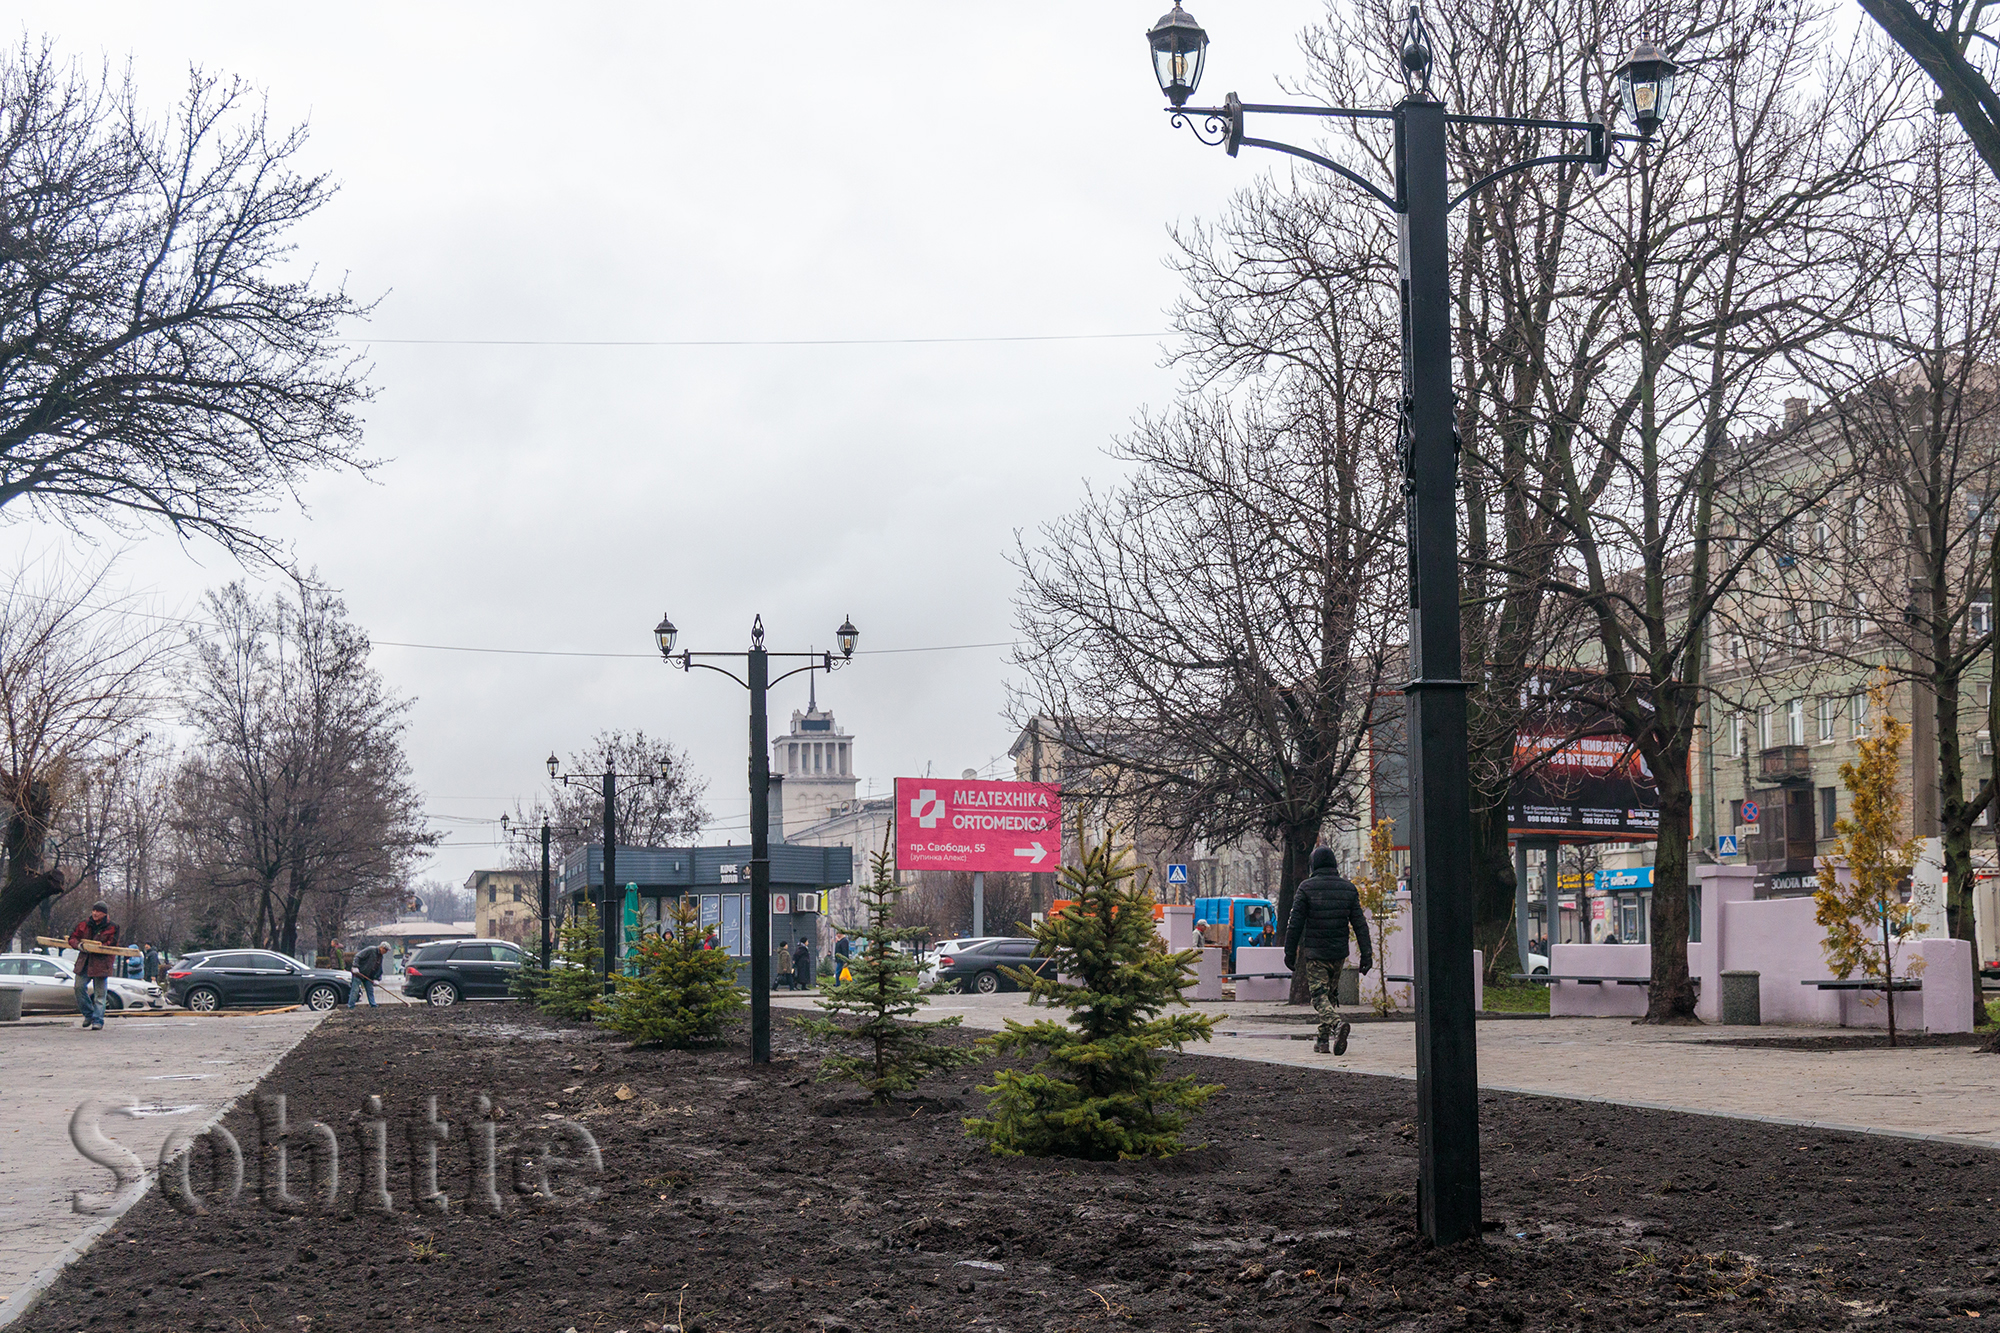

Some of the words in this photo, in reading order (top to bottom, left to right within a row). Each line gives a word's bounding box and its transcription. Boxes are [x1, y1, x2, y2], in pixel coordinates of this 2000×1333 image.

[953, 790, 1049, 808] МЕДТЕХНІКА
[952, 815, 1049, 832] ORTOMEDICA
[910, 843, 926, 852] пр.
[927, 842, 973, 854] Свободи,
[974, 843, 986, 853] 55
[910, 853, 942, 861] (зупинка
[943, 854, 967, 862] Алекс)
[1771, 878, 1801, 890] ЗОЛОТА
